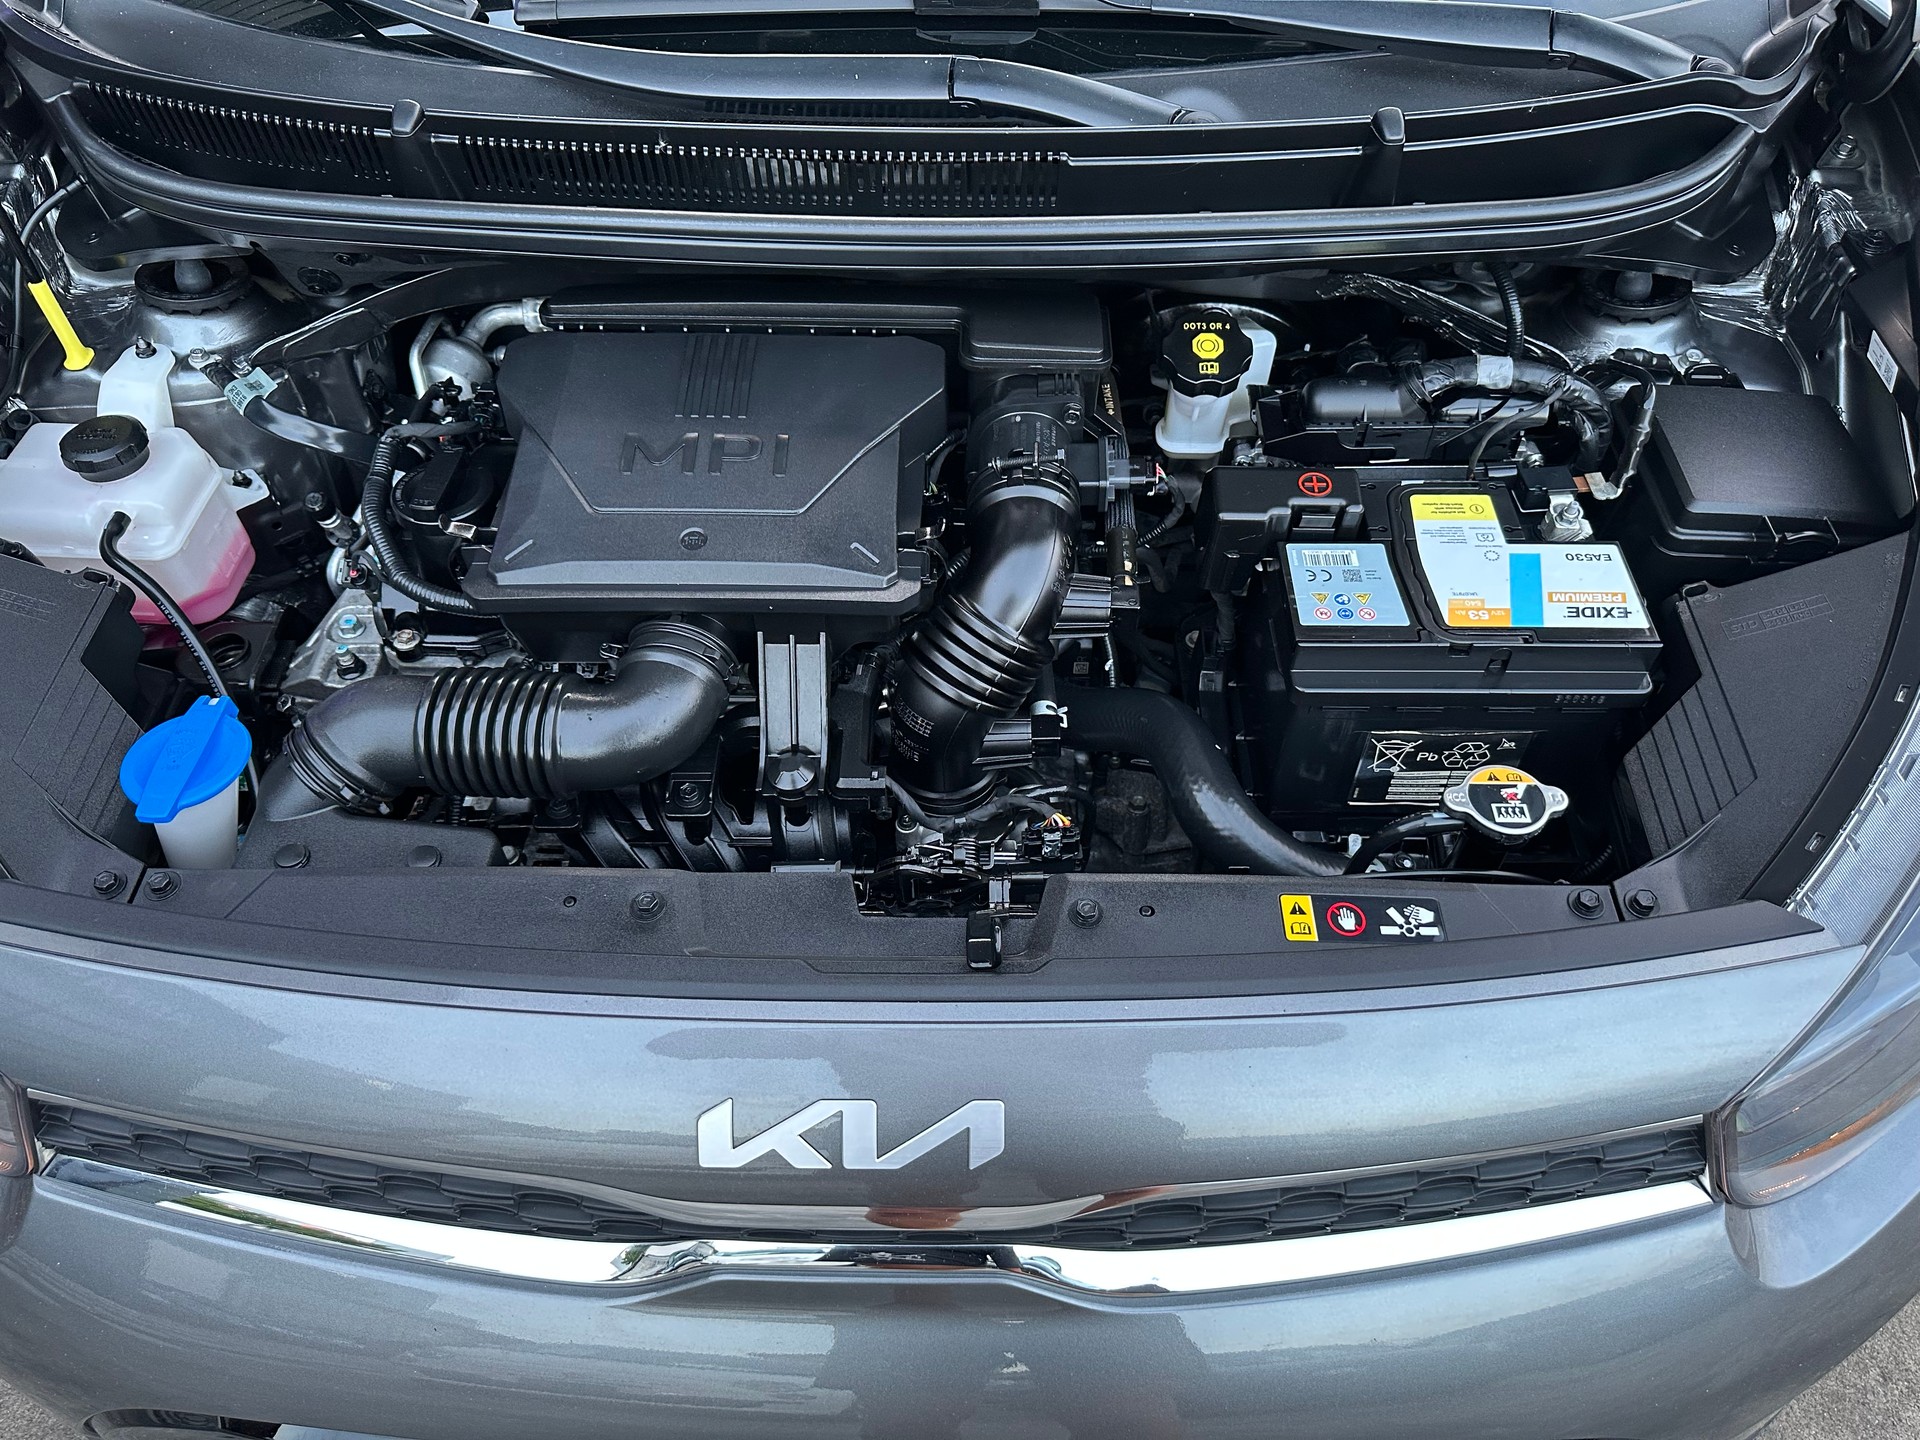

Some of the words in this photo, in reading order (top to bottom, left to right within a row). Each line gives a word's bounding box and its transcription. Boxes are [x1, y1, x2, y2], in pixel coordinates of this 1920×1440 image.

[1183, 322, 1207, 330] DOT3
[1209, 322, 1223, 330] OR
[1101, 383, 1114, 409] INTAKE
[620, 431, 790, 478] MPI
[1565, 553, 1613, 561] EA530
[1305, 569, 1332, 582] CE
[1552, 593, 1623, 602] PREMIUM
[1467, 610, 1489, 620] 53
[1566, 606, 1632, 618] EXIDE
[1416, 752, 1438, 762] Pb
[697, 1097, 1005, 1170] KIA
